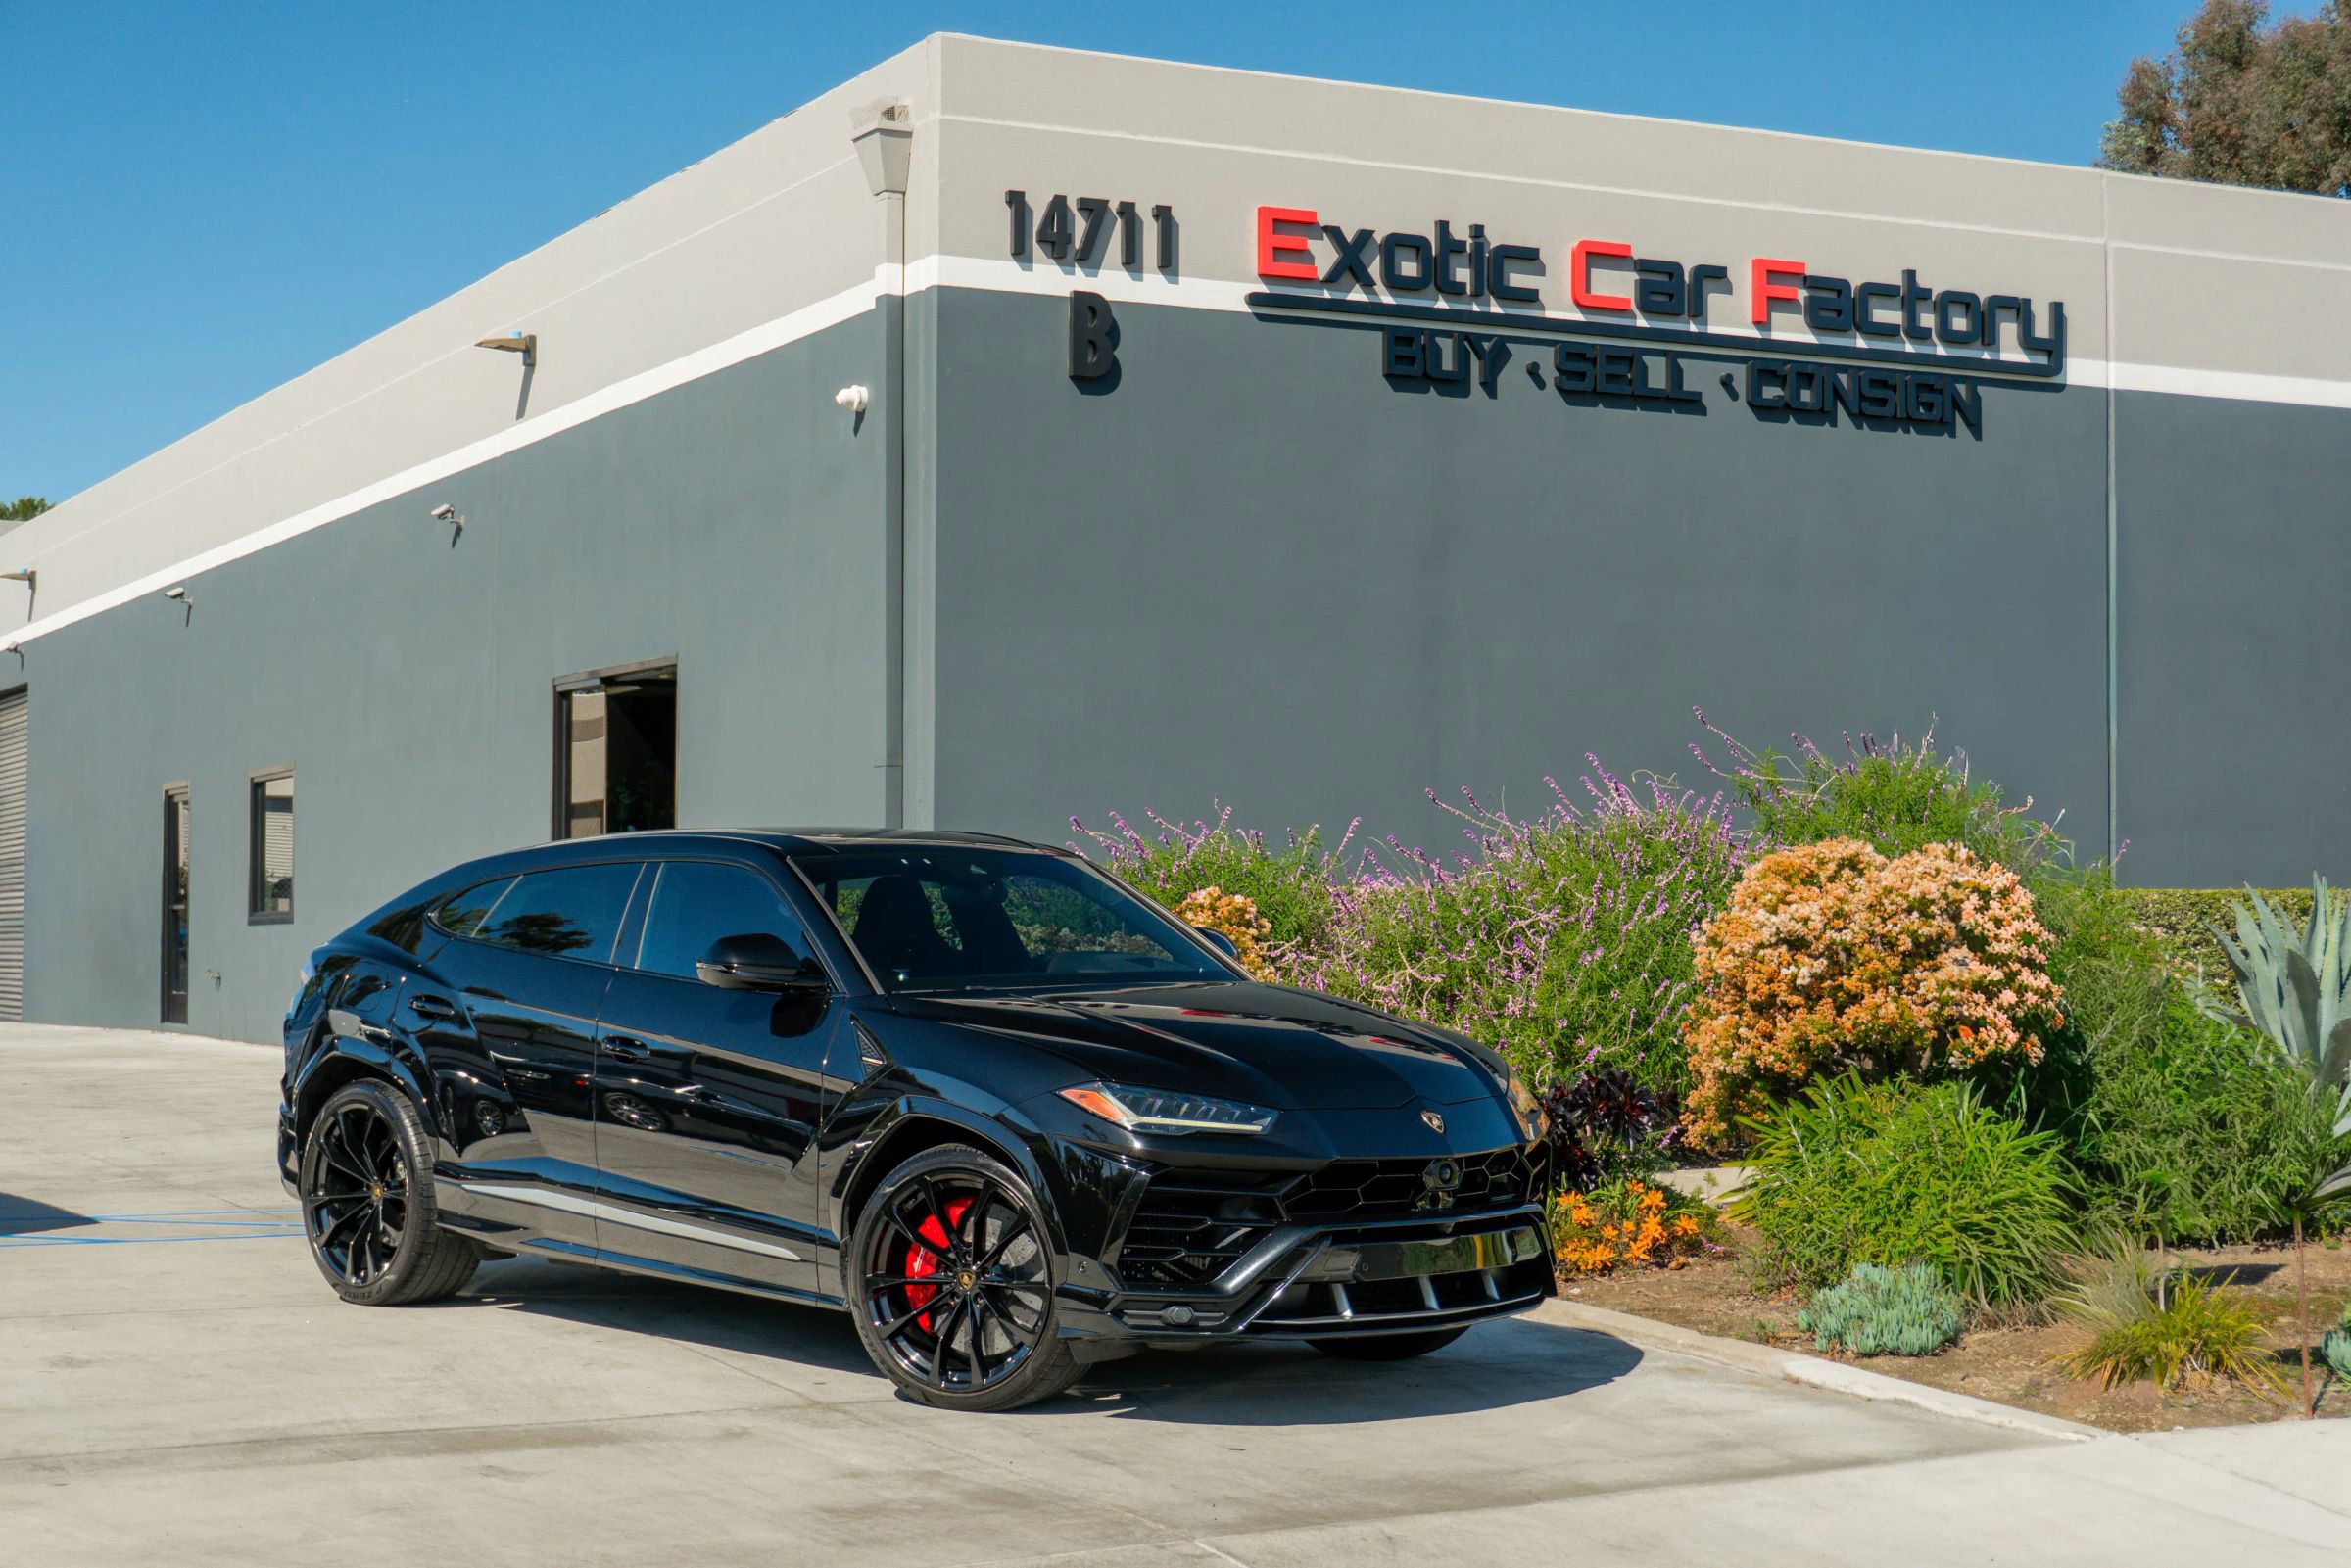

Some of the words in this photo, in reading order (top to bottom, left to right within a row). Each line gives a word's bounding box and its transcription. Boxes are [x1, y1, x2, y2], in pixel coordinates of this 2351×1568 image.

[1005, 190, 1173, 268] 14711
[1069, 290, 1114, 380] B
[1257, 206, 1540, 303] Exotic
[1571, 239, 1728, 318] Car
[1751, 258, 2064, 377] Factory
[1382, 327, 1503, 384] BUY
[1554, 343, 1703, 401] SELL
[1746, 360, 1978, 426] CONSIGN
